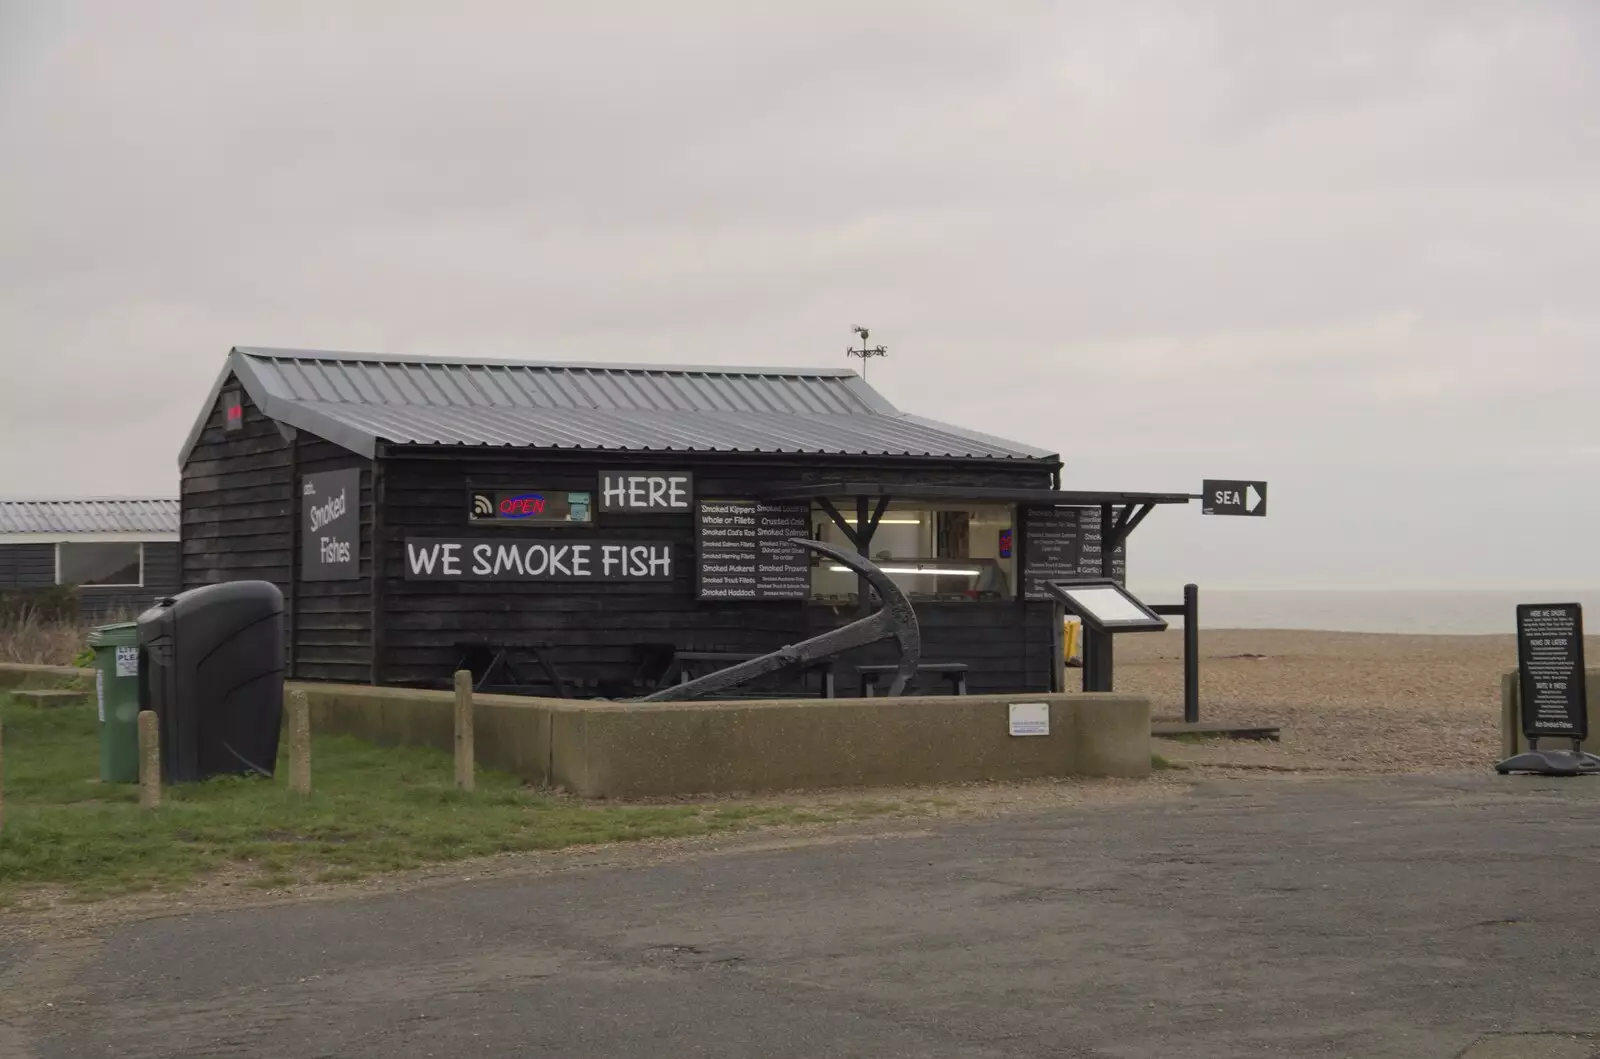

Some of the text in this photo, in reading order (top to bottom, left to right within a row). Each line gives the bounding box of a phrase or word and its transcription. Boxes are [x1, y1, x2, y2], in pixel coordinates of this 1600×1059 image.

[604, 476, 688, 508] HERE
[1215, 490, 1240, 505] SEA
[310, 486, 346, 532] Smoked
[500, 499, 545, 514] OPEN
[701, 504, 755, 514] Smoked Kippers
[320, 536, 350, 564] Fishes
[407, 544, 671, 576] WE SMOKE FISH
